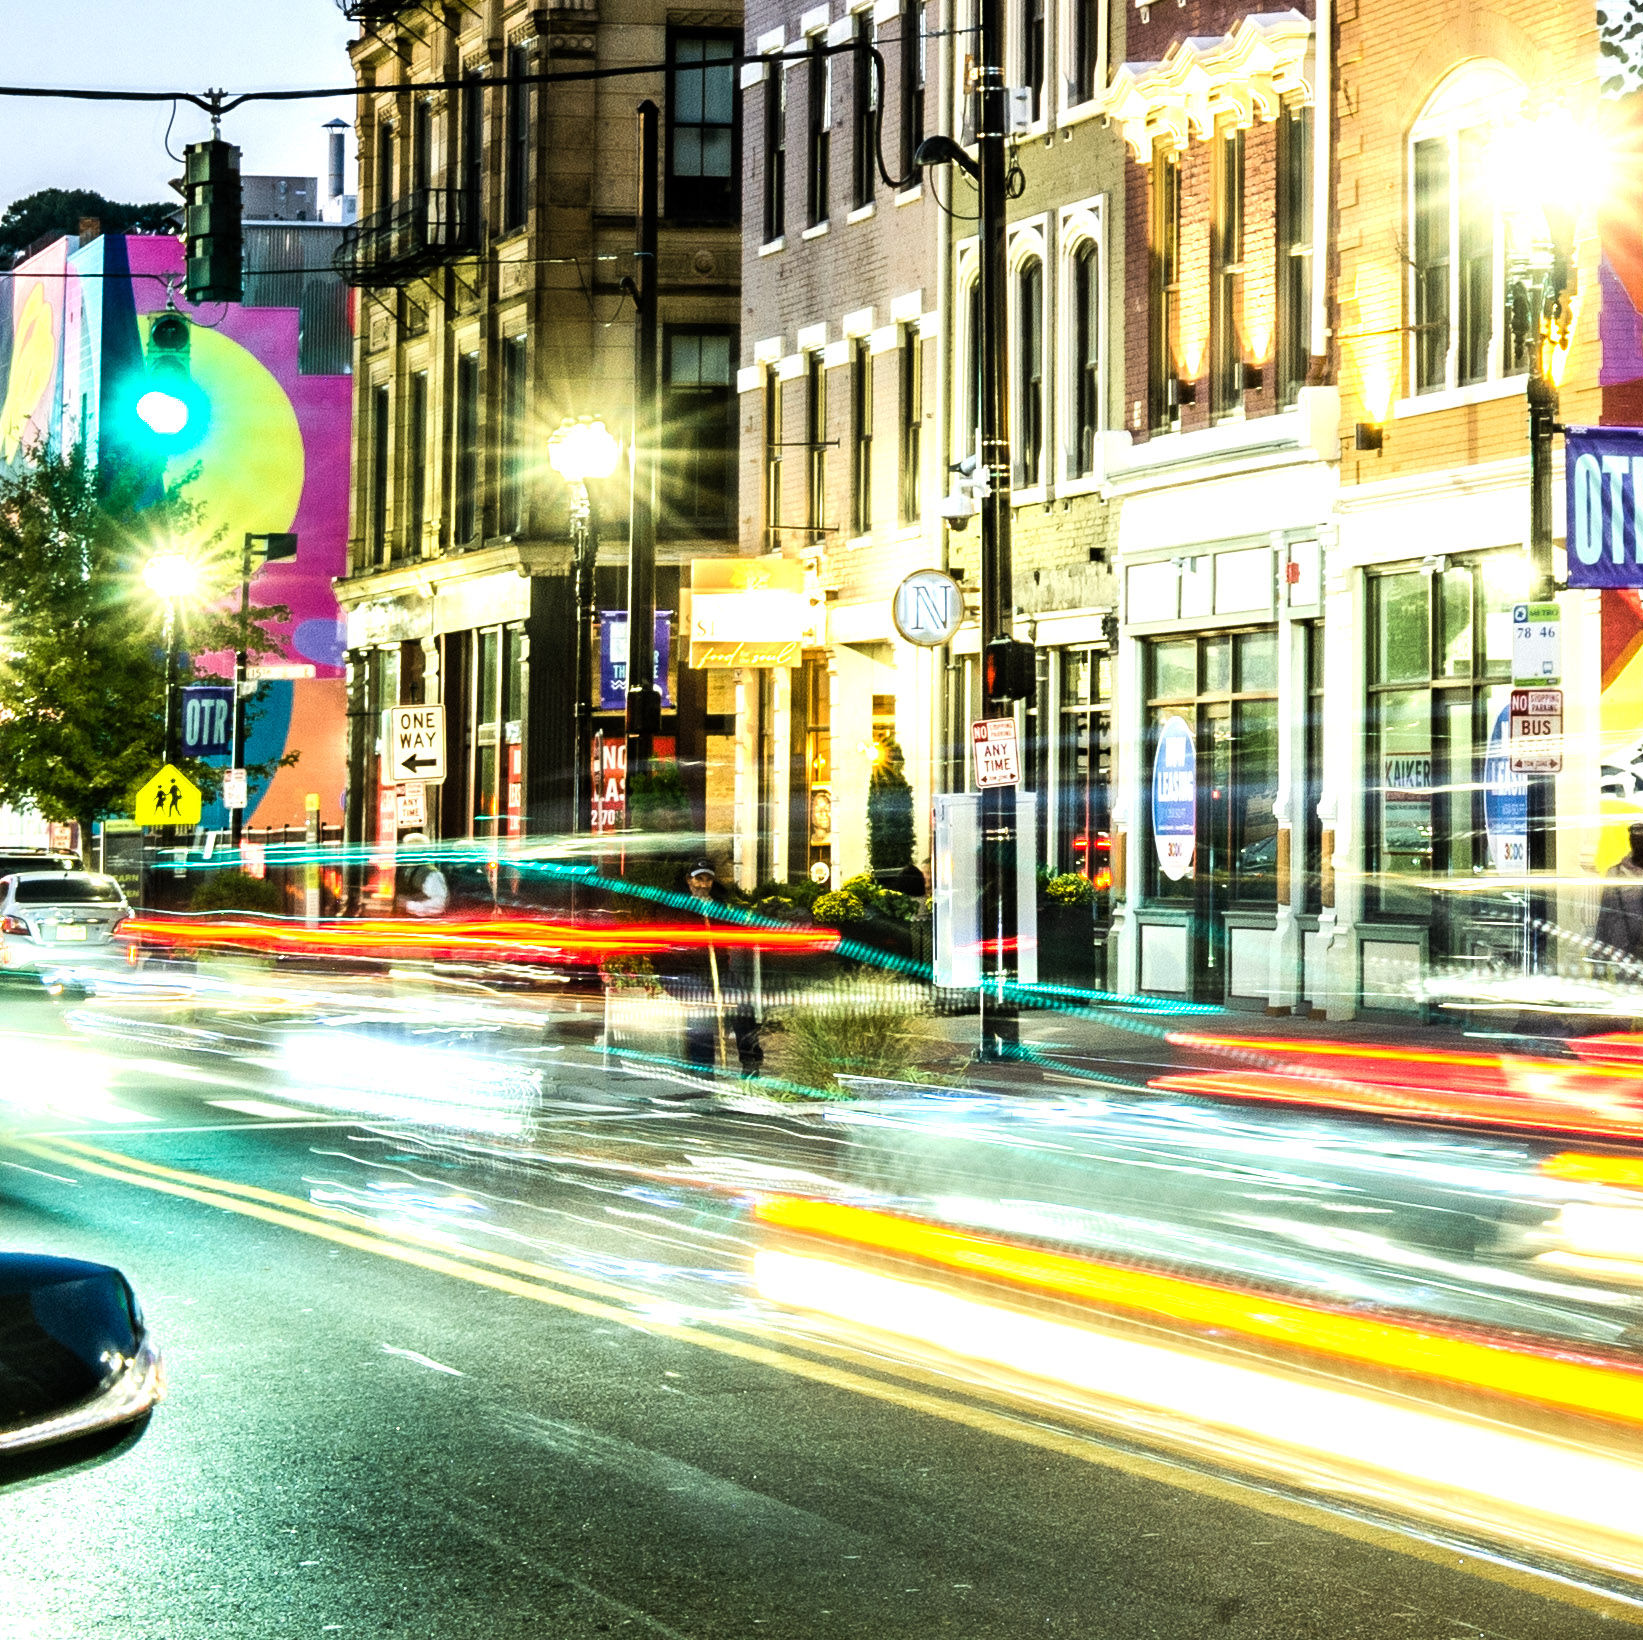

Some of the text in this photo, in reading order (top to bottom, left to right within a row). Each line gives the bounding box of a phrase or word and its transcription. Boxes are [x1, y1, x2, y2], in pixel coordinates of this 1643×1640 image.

[911, 585, 951, 631] N
[1517, 626, 1555, 638] 78 46
[696, 642, 744, 669] food
[1512, 695, 1527, 711] NO
[183, 698, 229, 747] OTR
[401, 713, 435, 729] ONE
[1522, 720, 1551, 735] BUS
[400, 732, 436, 749] WAY
[974, 726, 987, 739] NO
[984, 744, 1007, 757] ANY
[984, 758, 1010, 772] TIME
[1158, 771, 1194, 801] LEASING
